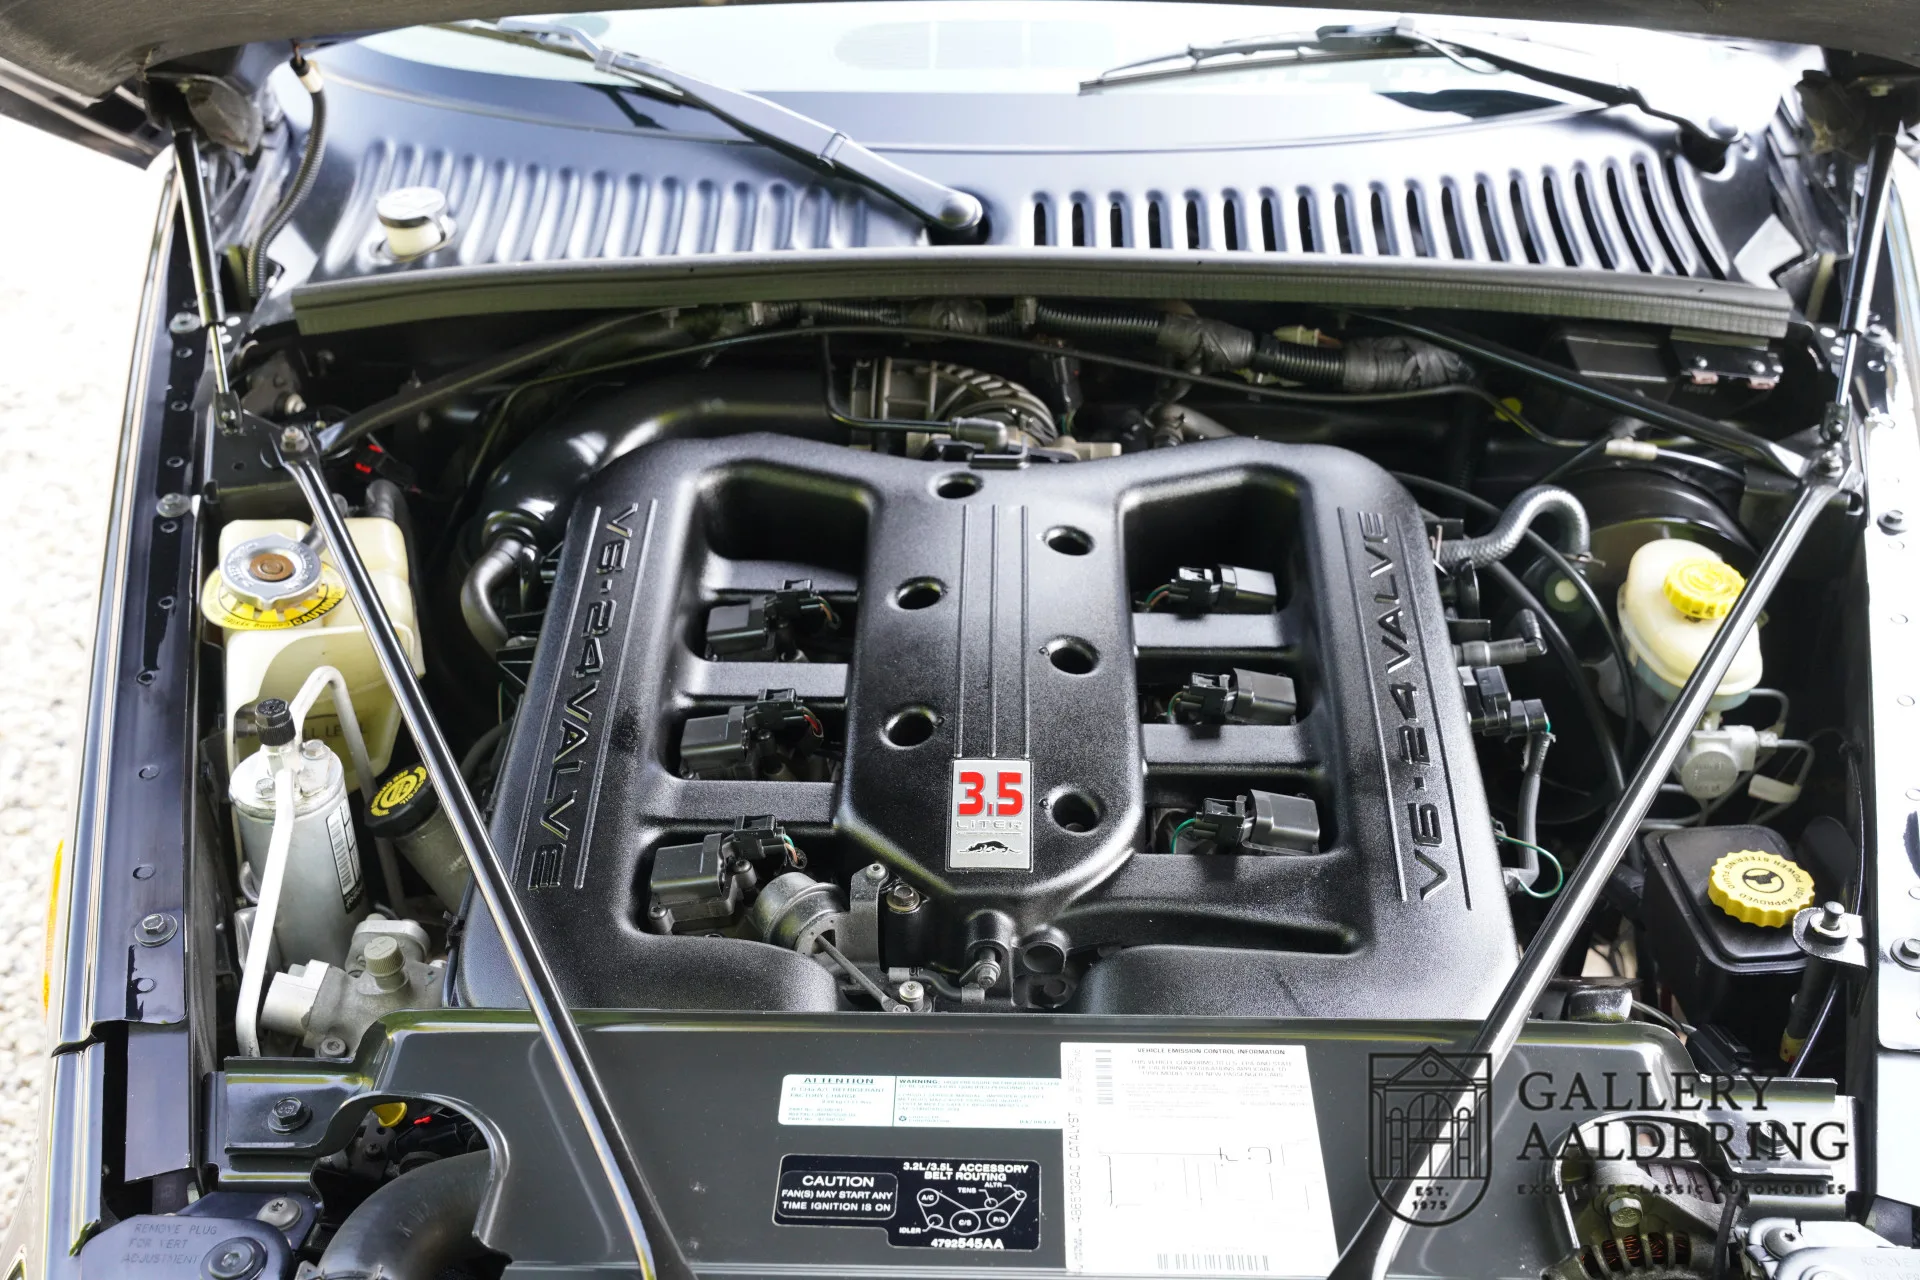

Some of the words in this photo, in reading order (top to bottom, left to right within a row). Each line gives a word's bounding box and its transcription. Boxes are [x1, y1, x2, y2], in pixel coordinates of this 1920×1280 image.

[957, 770, 1025, 817] 3.5
[956, 820, 1023, 830] LITER
[1725, 855, 1770, 870] STEERING
[1773, 860, 1803, 884] POWER
[1722, 870, 1736, 890] FLUID
[1739, 892, 1793, 906] APPROVED
[1793, 886, 1805, 900] USE
[1068, 1112, 1080, 1159] CATALYST
[903, 1162, 953, 1172] 3.2L/3.5L
[959, 1163, 1029, 1173] ACCESSORY
[802, 1175, 875, 1187] CAUTION
[924, 1171, 954, 1180] BELT
[955, 1171, 1007, 1181] ROUTING
[781, 1189, 814, 1199] FAN(S)
[816, 1190, 837, 1199] MAY
[839, 1191, 871, 1199] START
[871, 1191, 893, 1200] ANY
[782, 1201, 807, 1209] TIME
[811, 1202, 858, 1211] IGNITION
[861, 1203, 872, 1211] IS
[875, 1203, 891, 1212] ON
[134, 1223, 182, 1234] REMOVE
[189, 1225, 218, 1235] PLUG
[128, 1238, 153, 1248] FOR
[931, 1238, 1005, 1249] 4792545AA
